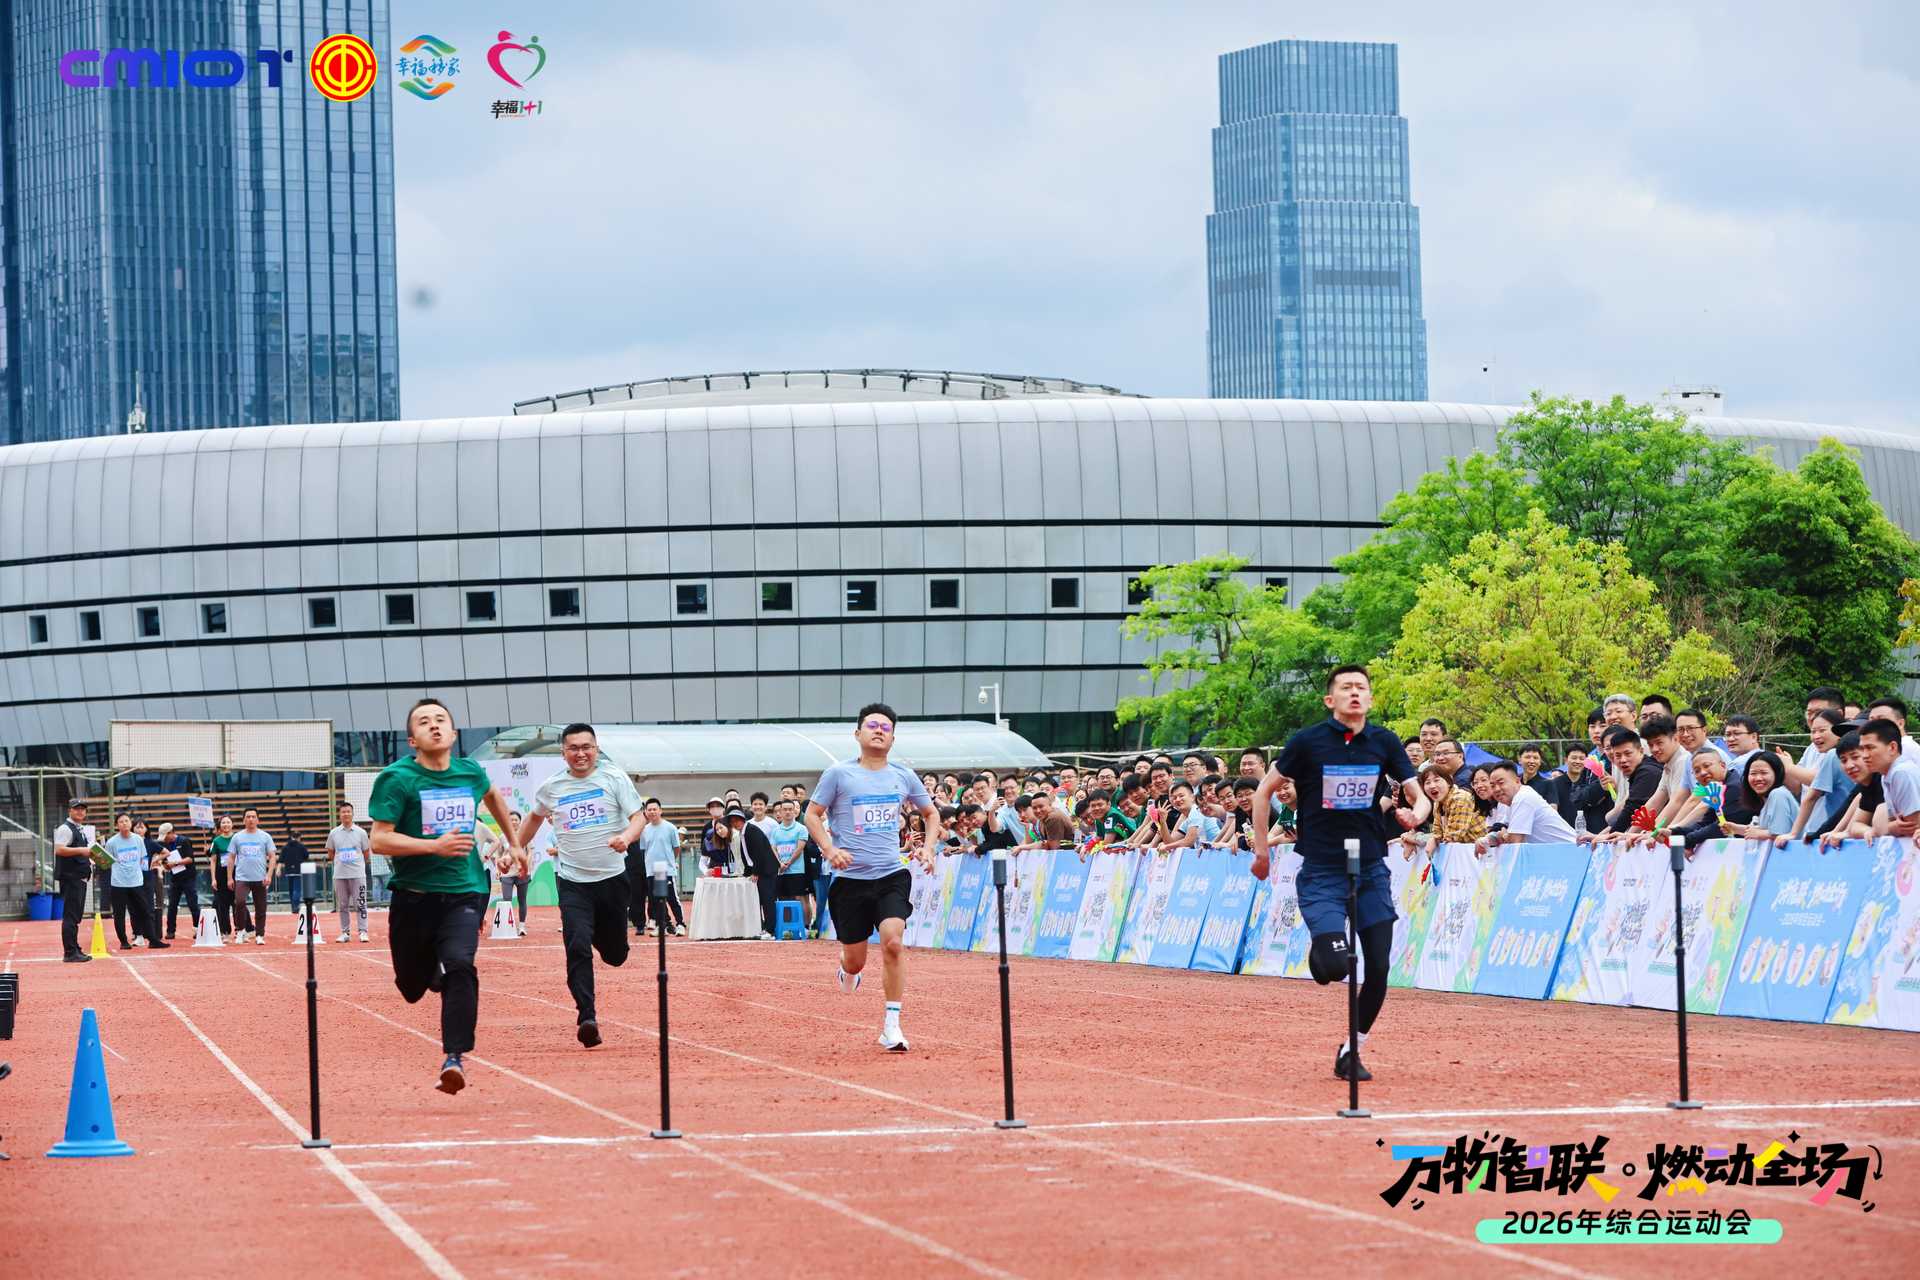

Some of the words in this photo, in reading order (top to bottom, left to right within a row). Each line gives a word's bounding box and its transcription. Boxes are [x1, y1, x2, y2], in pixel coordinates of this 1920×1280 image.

[1336, 782, 1368, 798] 038
[435, 804, 466, 822] 034
[570, 803, 596, 820] 035
[865, 808, 891, 823] 036
[200, 913, 205, 937] 1
[213, 915, 219, 937] 1
[298, 913, 305, 936] 2
[311, 913, 319, 935] 2
[494, 907, 500, 928] 4
[508, 907, 513, 928] 4
